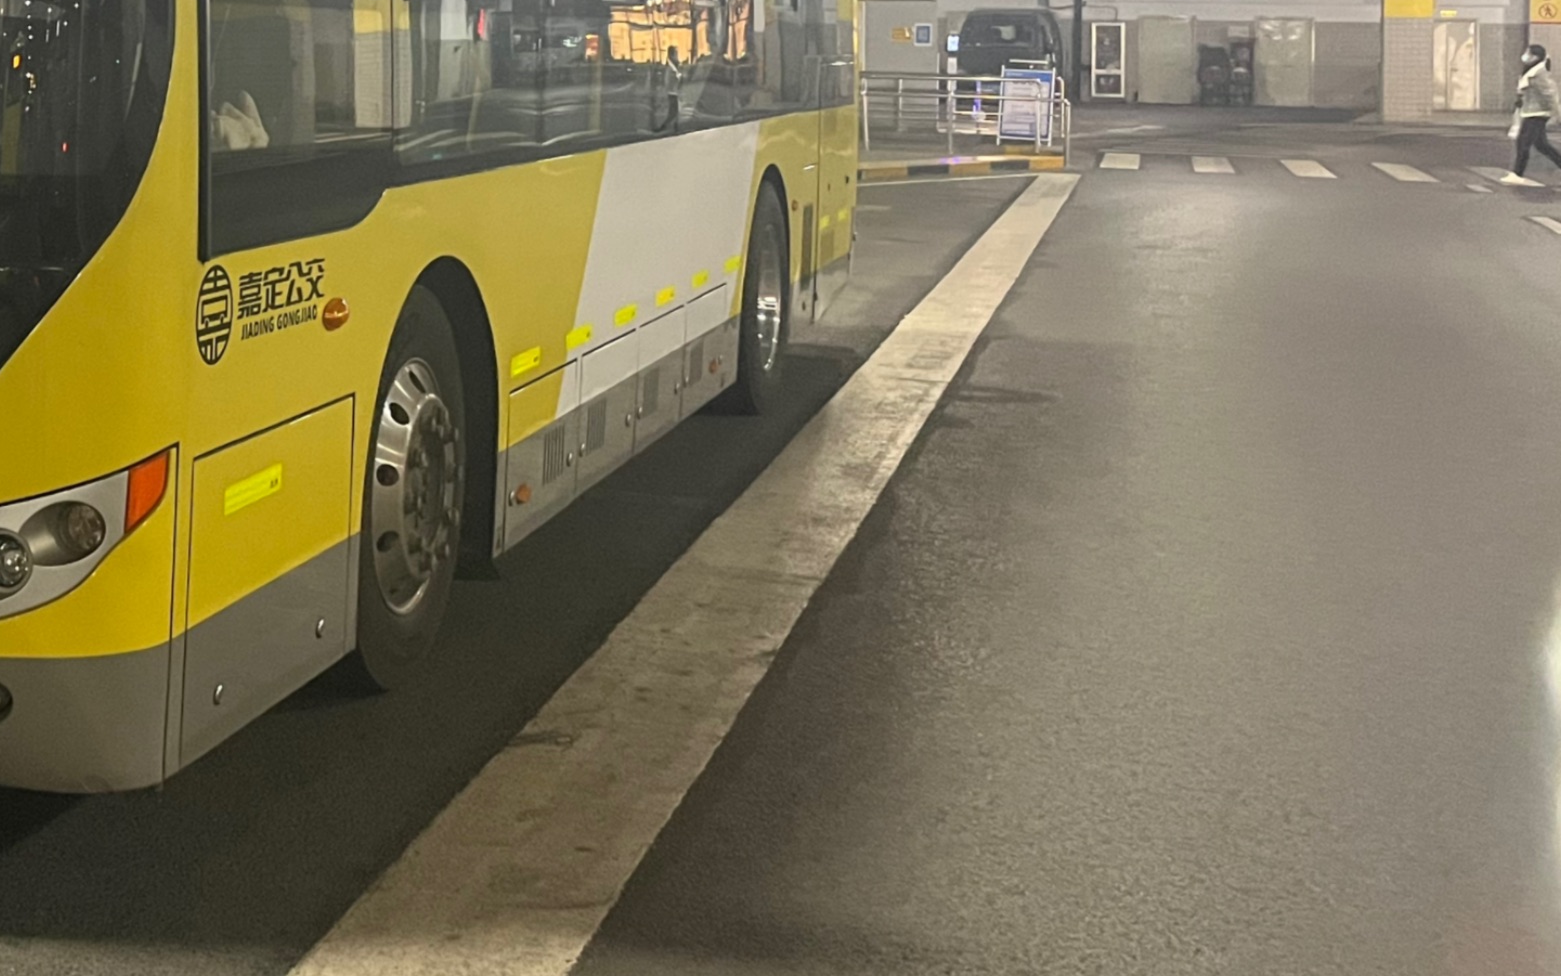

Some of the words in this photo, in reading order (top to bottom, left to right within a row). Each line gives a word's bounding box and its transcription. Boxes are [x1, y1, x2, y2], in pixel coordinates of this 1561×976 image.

[237, 257, 326, 320] 嘉定公交
[241, 316, 275, 341] JIADING
[277, 304, 318, 331] GONGJIAO
